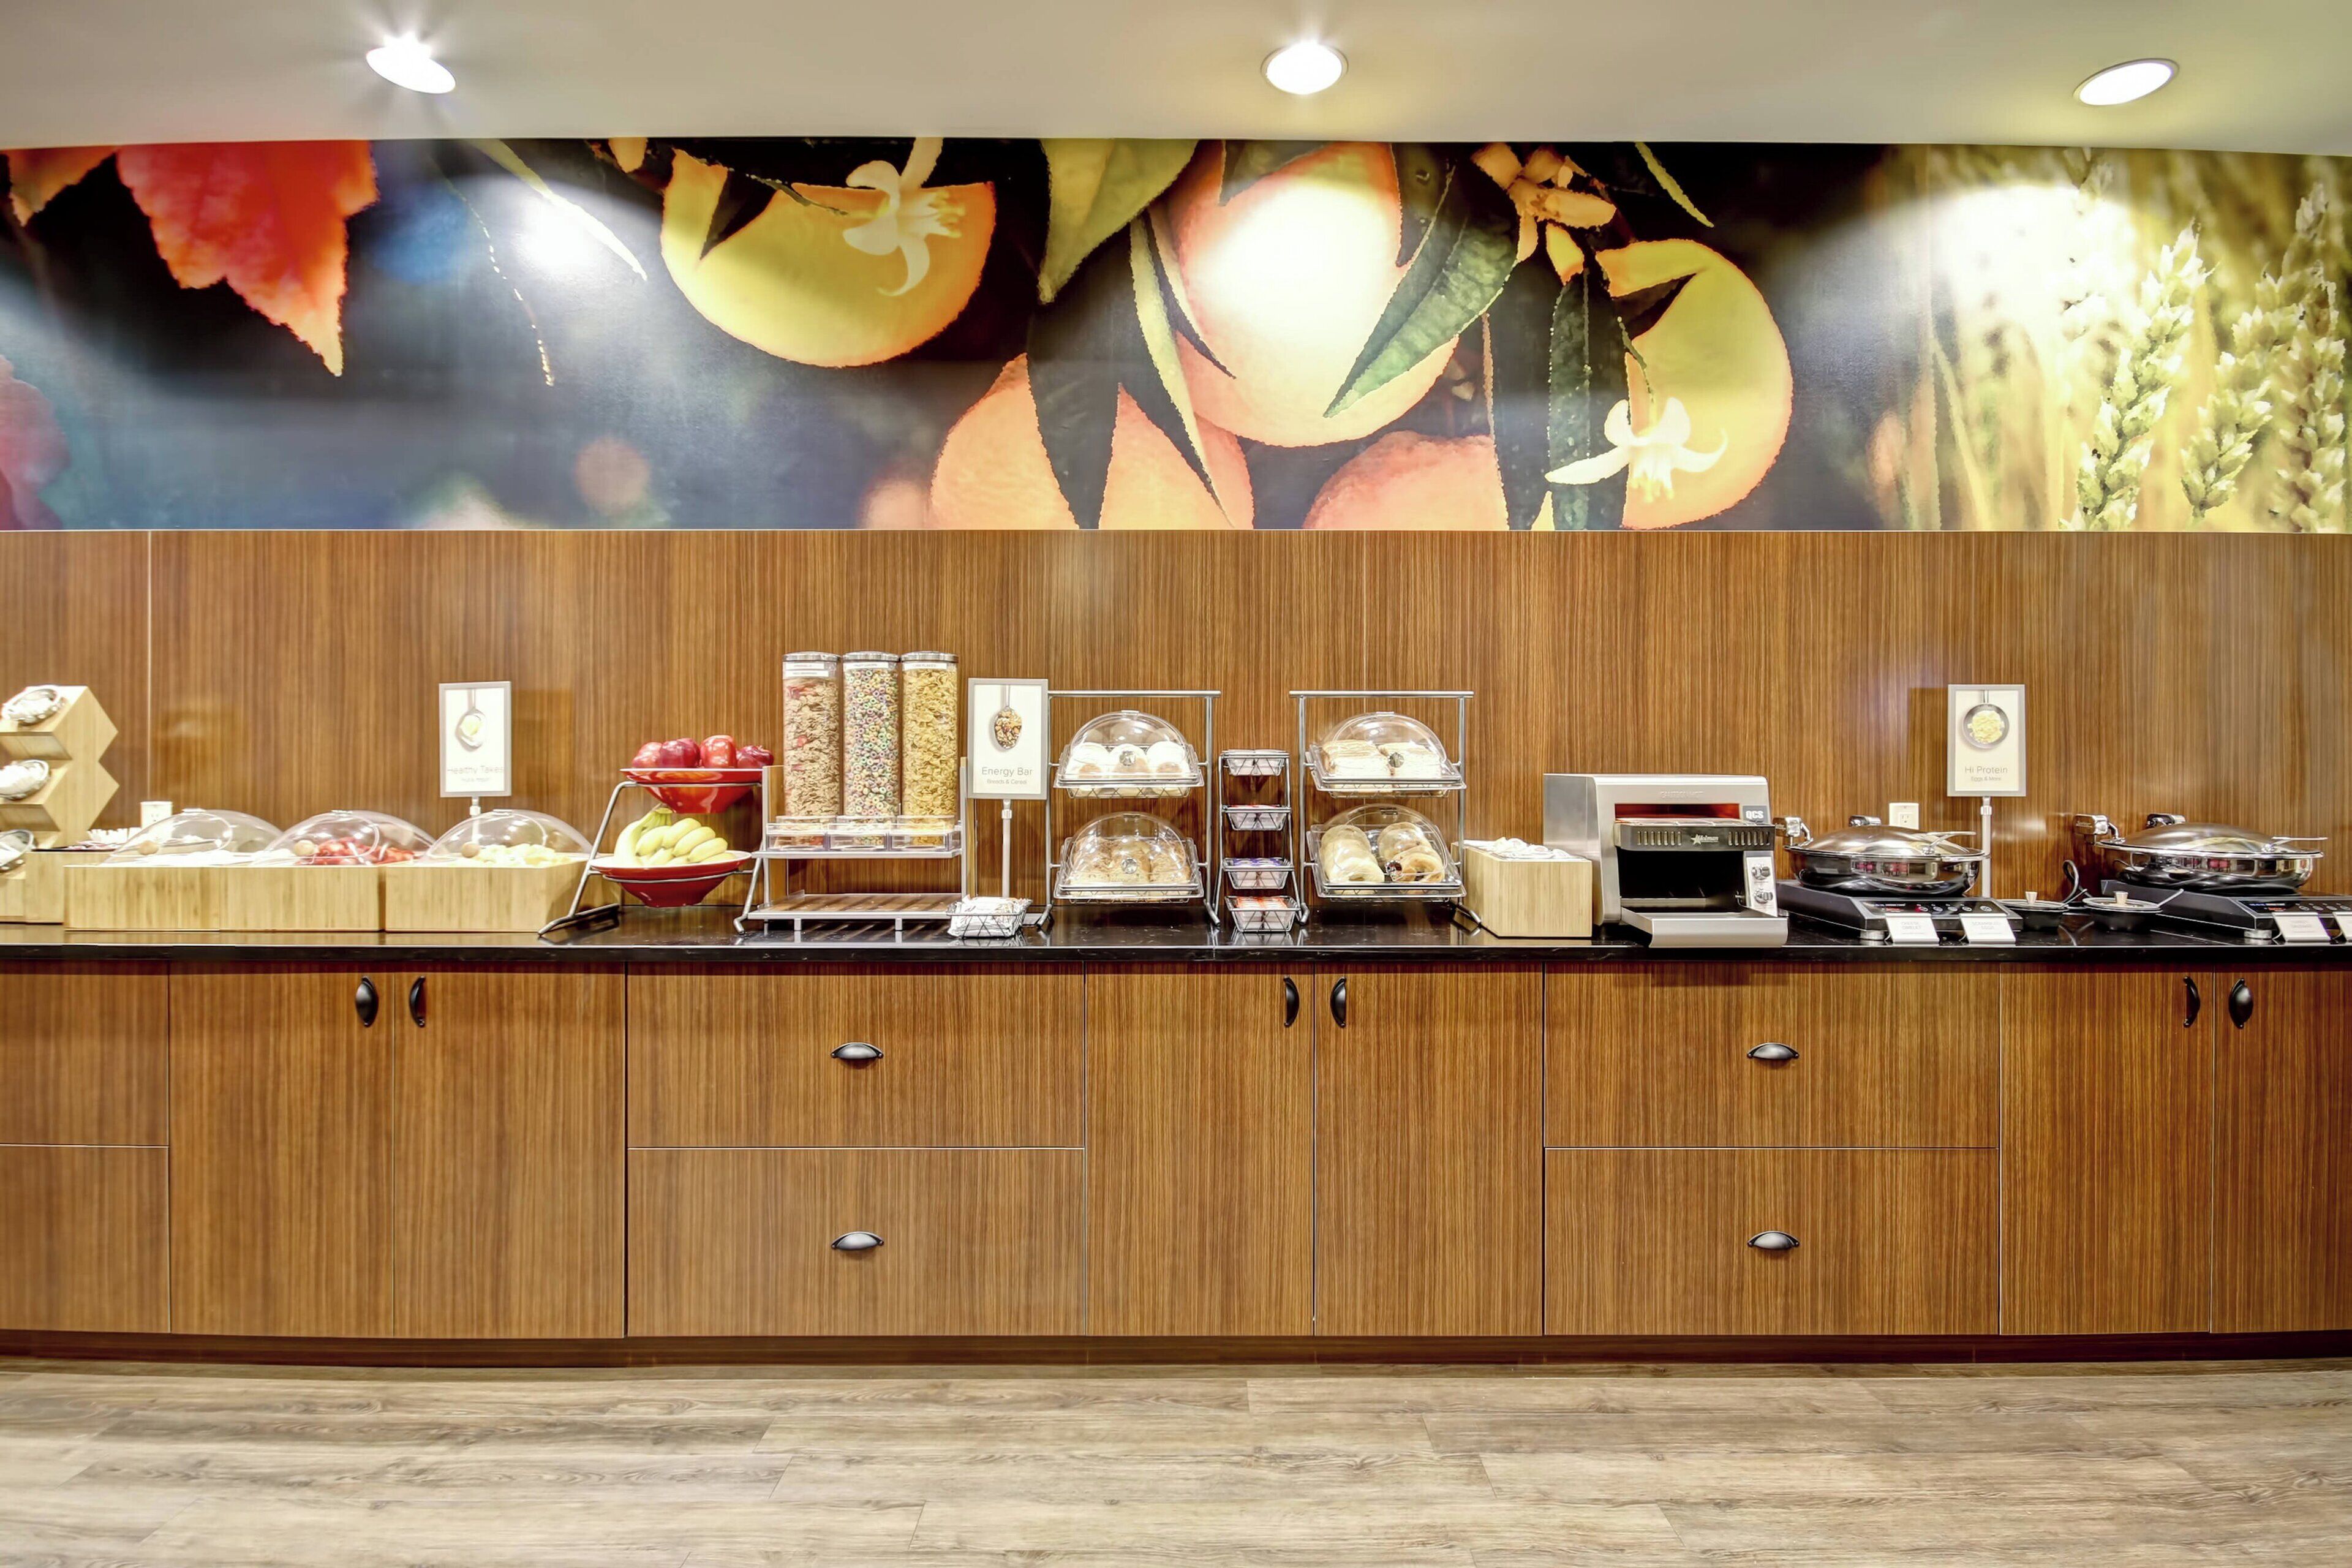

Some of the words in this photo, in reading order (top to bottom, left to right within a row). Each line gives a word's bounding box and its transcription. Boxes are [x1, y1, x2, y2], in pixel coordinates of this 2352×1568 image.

[981, 767, 1015, 777] Energy
[1017, 767, 1033, 775] Bar
[1977, 766, 2008, 774] Protein
[1745, 810, 1764, 820] QCS
